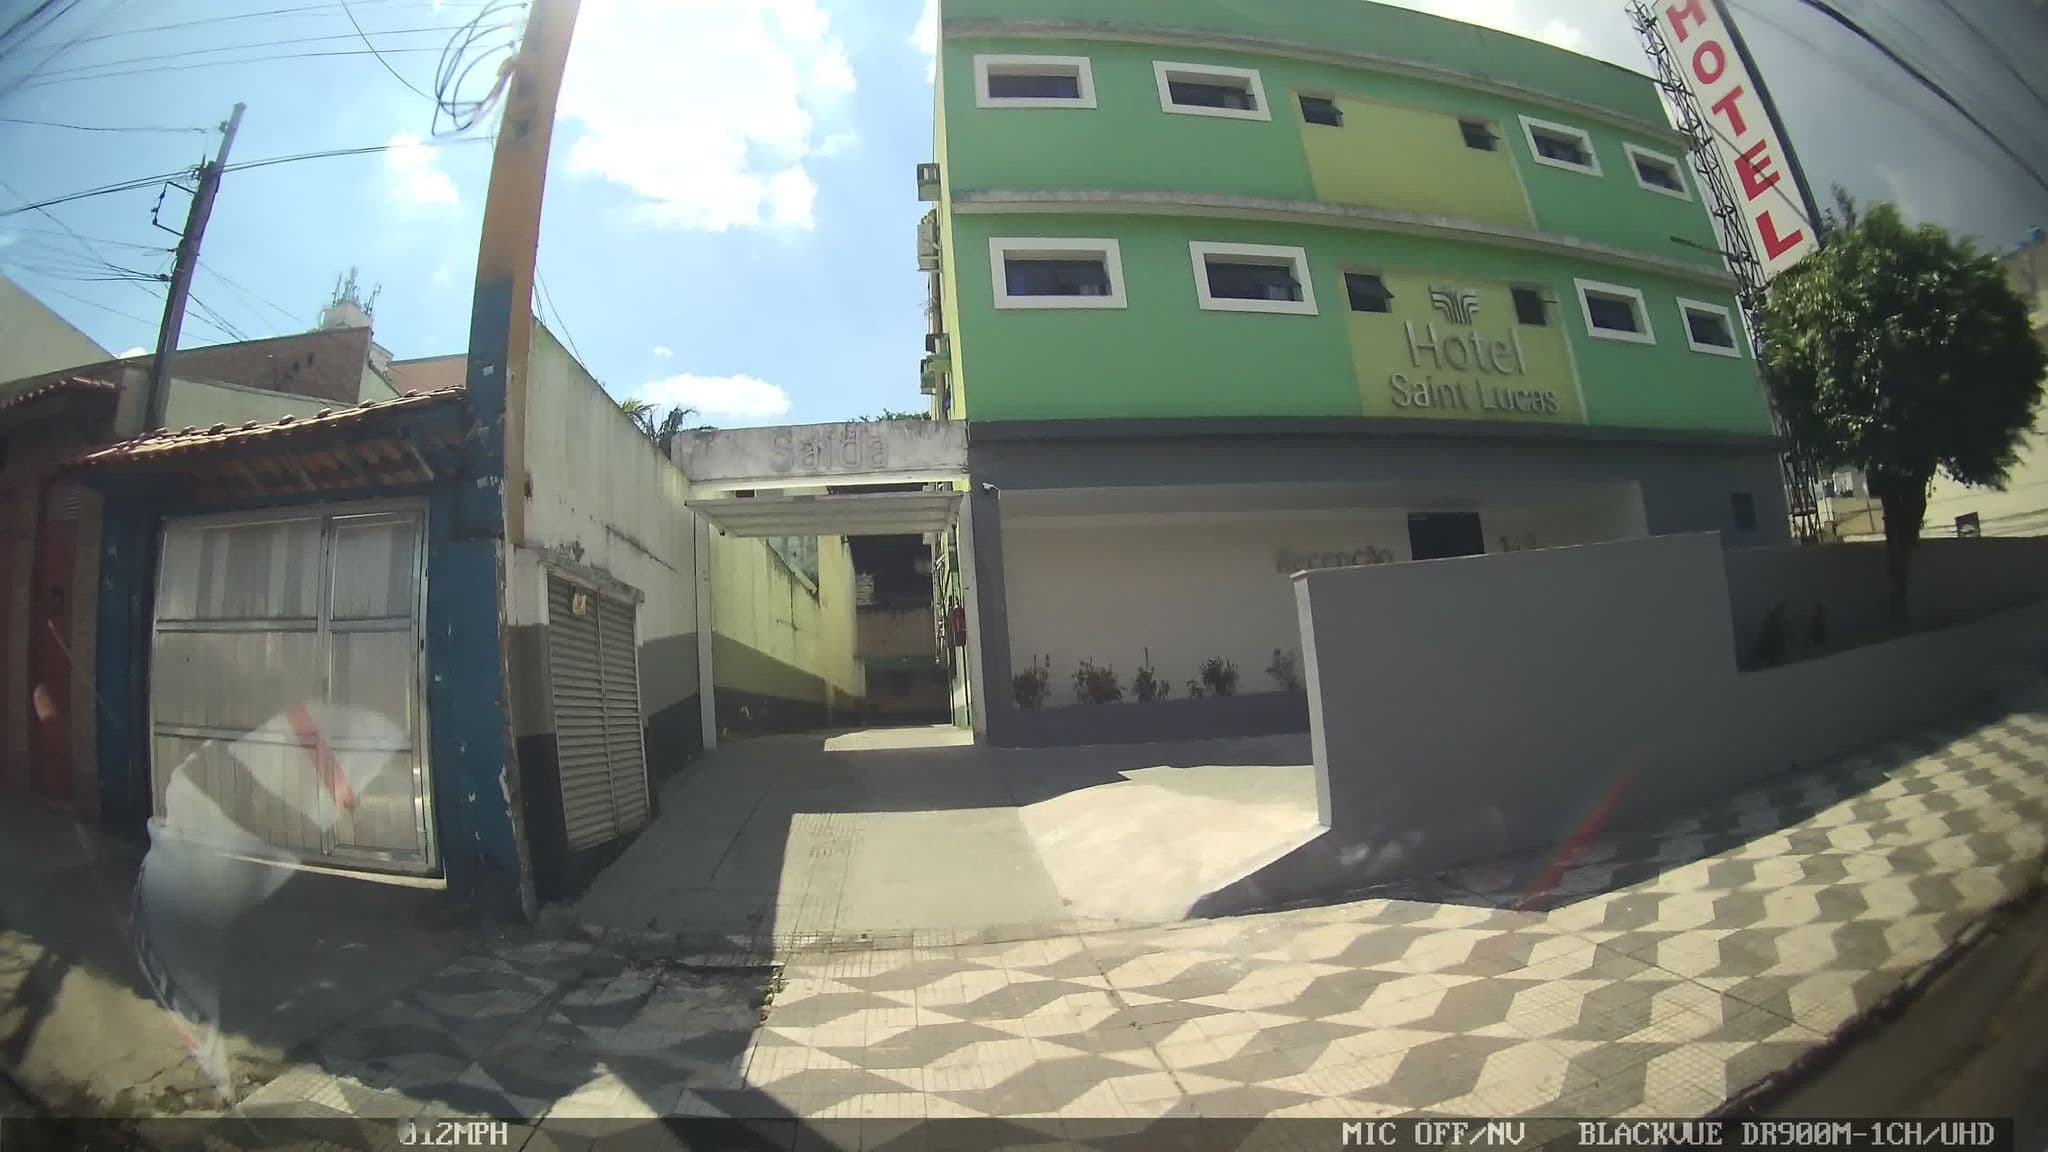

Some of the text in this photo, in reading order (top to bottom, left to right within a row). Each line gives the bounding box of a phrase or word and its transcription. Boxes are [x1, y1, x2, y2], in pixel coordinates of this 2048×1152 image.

[1665, 0, 1804, 261] HOTEL
[1404, 319, 1527, 375] Hotel
[1390, 373, 1560, 414] Saint Lucas
